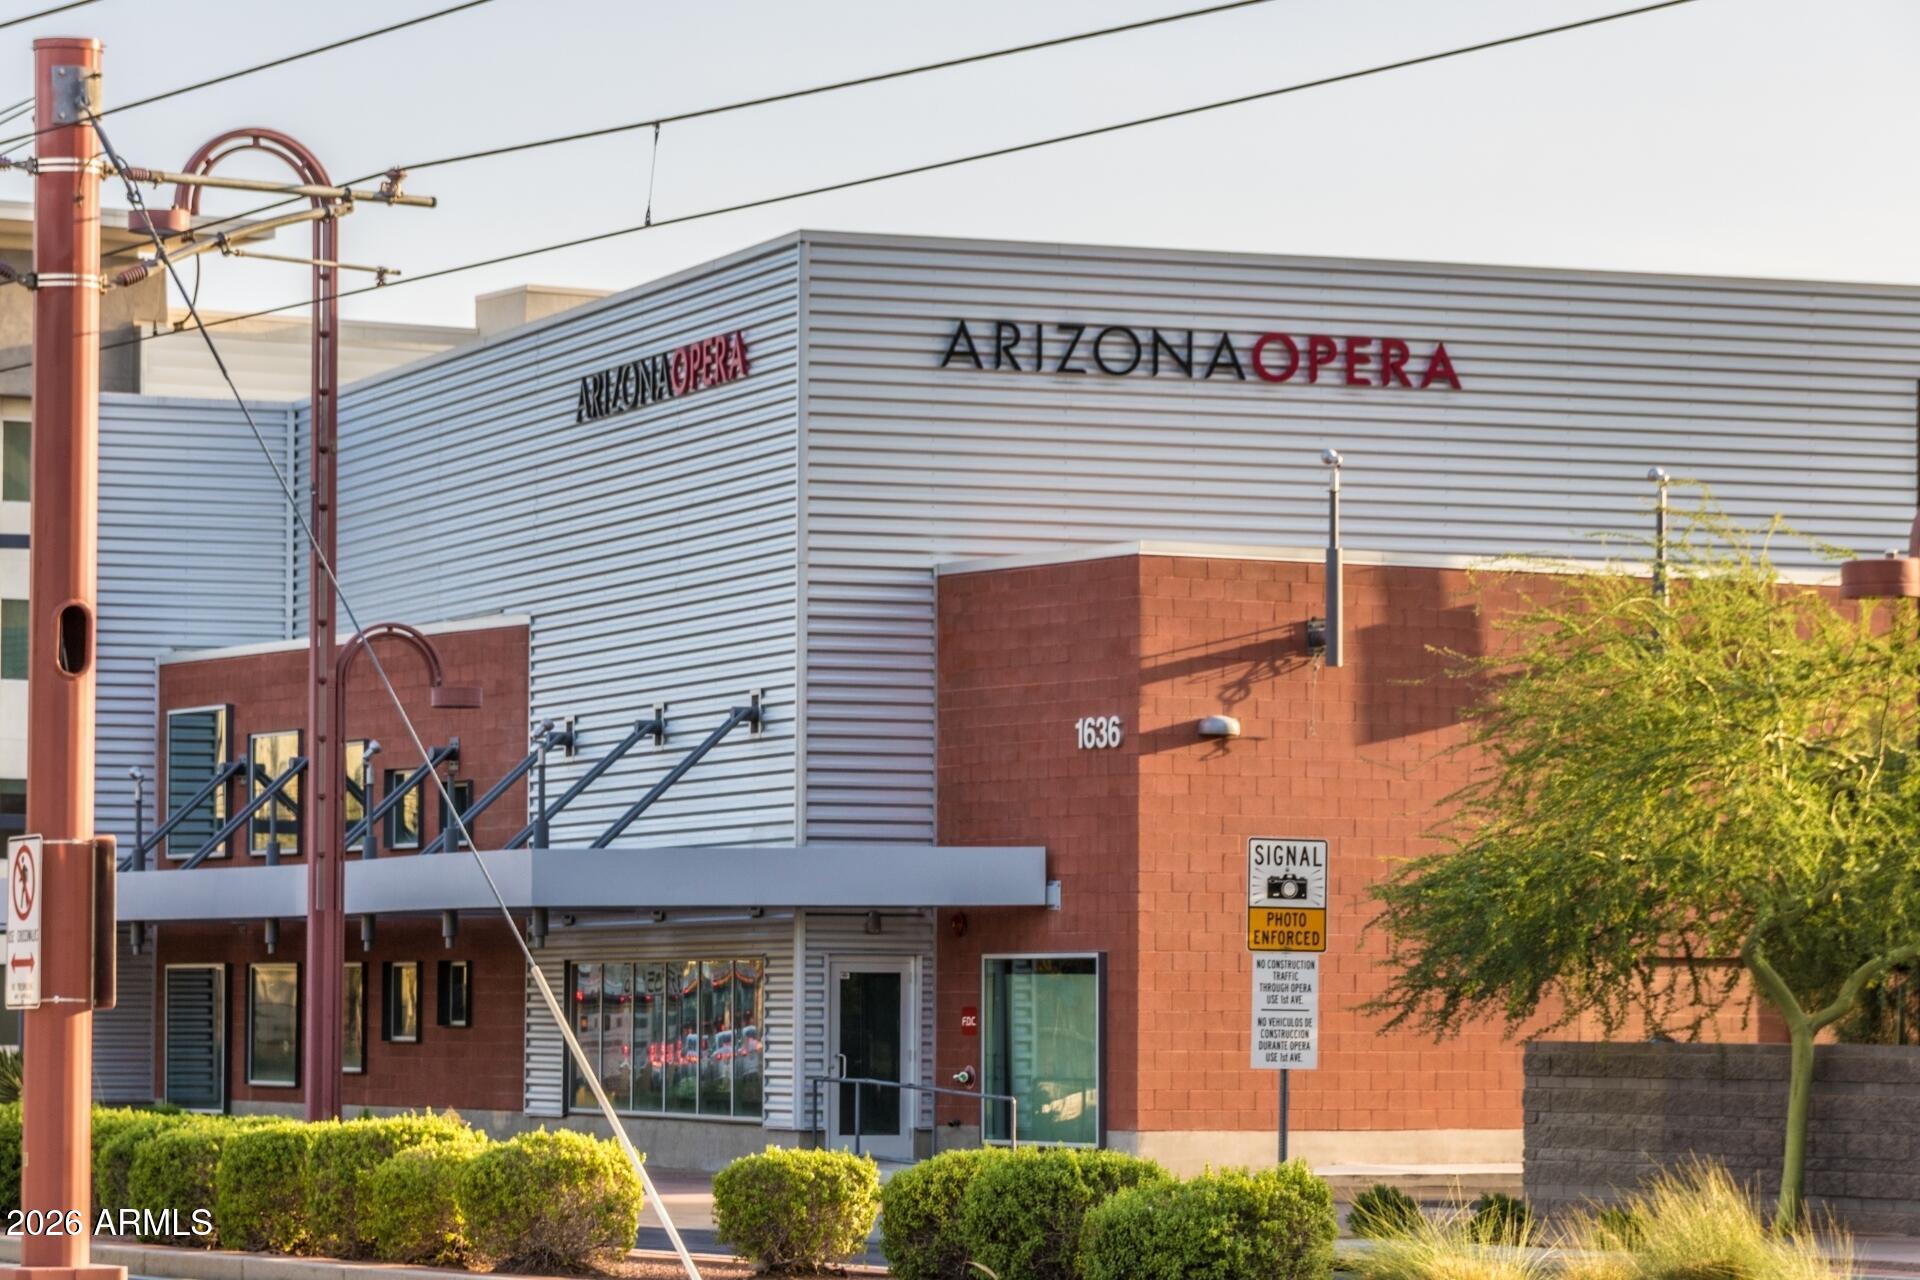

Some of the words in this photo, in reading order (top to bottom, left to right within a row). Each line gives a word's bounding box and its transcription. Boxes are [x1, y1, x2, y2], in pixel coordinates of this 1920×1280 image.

[941, 319, 1246, 381] ARIZONA
[1251, 331, 1462, 390] OPERA
[576, 352, 674, 423] ARIZONA
[670, 329, 750, 397] OPERA
[1075, 715, 1121, 750] 1636
[1254, 844, 1323, 867] SIGNAL
[1266, 911, 1308, 928] PHOTO
[1253, 930, 1321, 946] ENFORCED
[1256, 959, 1266, 969] NO
[1267, 959, 1316, 970] CONSTRUCTION
[1273, 971, 1299, 981] TRAFFIC
[1259, 982, 1289, 993] THROUGH
[1290, 983, 1312, 993] OPERA
[1266, 994, 1279, 1005] USE
[961, 1016, 977, 1027] FDC
[1257, 1017, 1267, 1027] NO
[1268, 1017, 1303, 1028] VEHICULOS
[1304, 1017, 1313, 1028] DE
[1260, 1028, 1310, 1039] CONSTRUCCION
[1258, 1040, 1288, 1051] DURANTE
[1289, 1040, 1311, 1051] OPERA
[1265, 1052, 1278, 1063] USE
